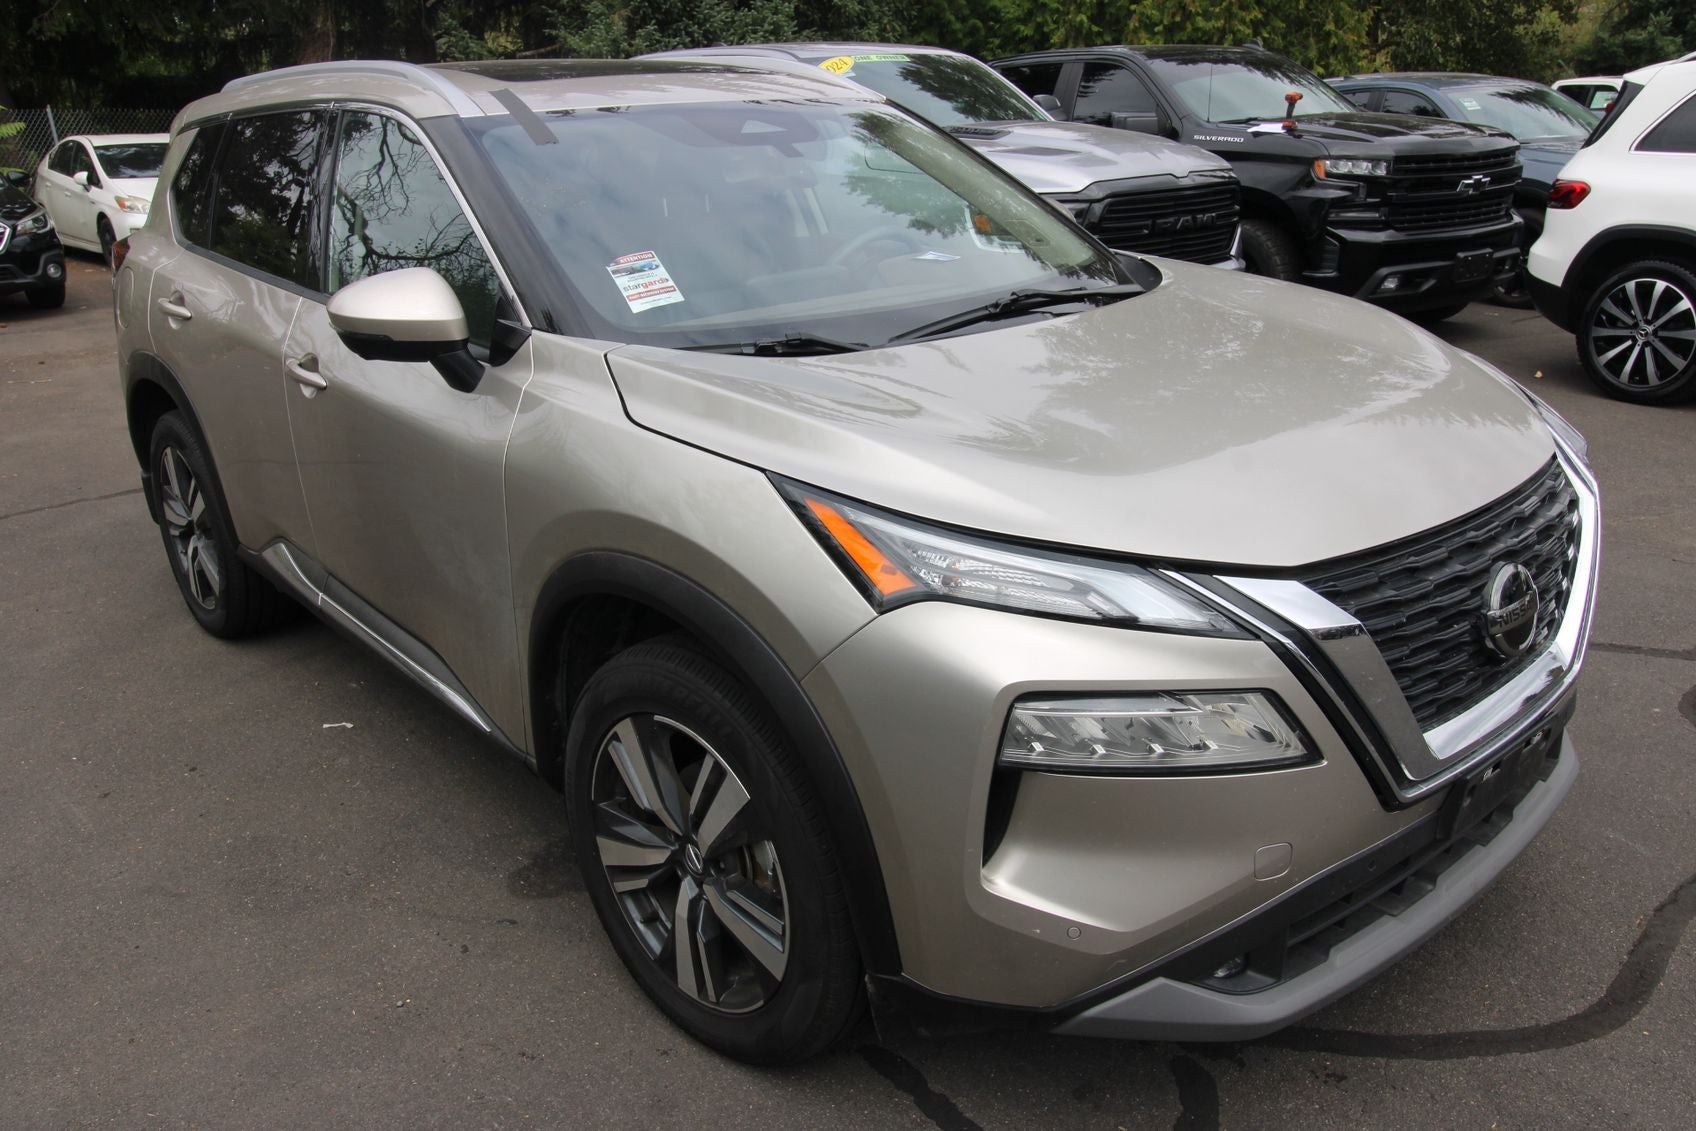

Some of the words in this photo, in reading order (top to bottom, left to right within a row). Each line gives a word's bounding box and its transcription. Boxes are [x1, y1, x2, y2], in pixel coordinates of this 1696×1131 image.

[1193, 135, 1244, 143] SILVERADO
[1152, 212, 1217, 236] RAM
[619, 252, 653, 264] ATTENTION
[1498, 601, 1533, 628] NISS
